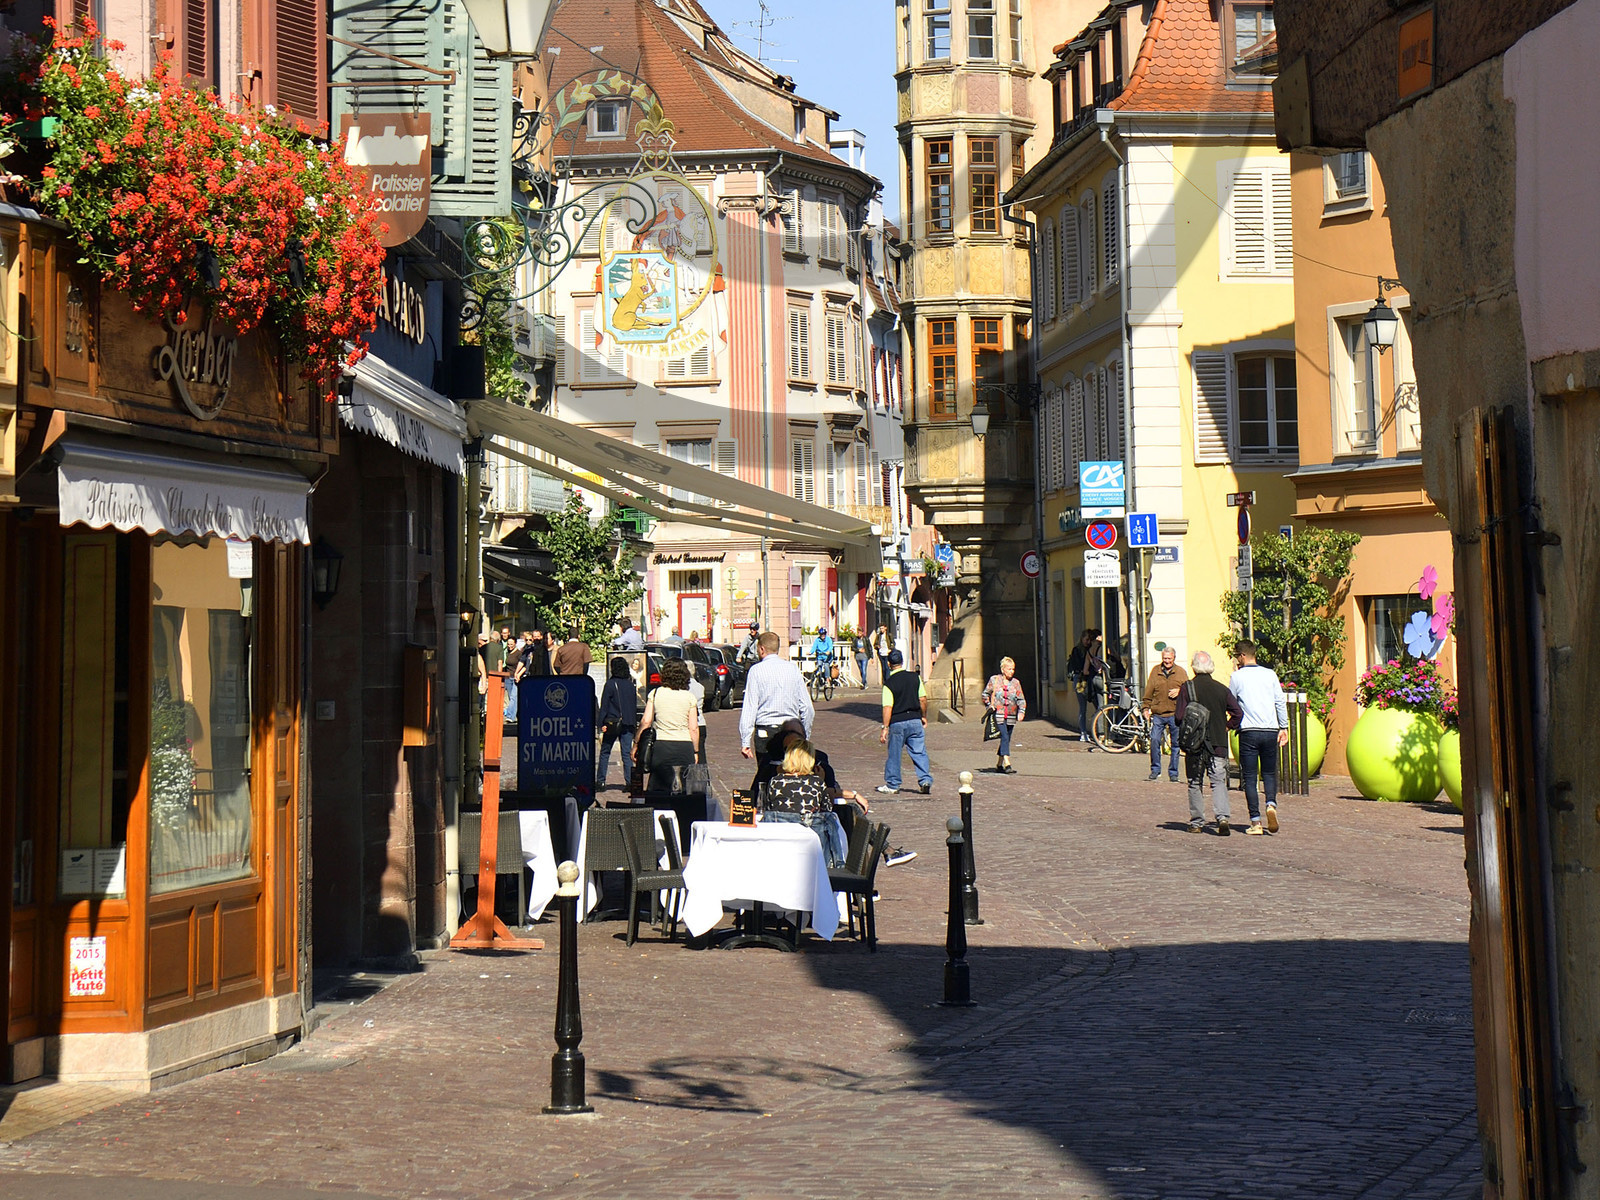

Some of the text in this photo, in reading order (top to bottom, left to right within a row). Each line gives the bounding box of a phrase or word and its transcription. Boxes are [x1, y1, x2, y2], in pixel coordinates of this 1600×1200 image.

[369, 194, 425, 212] colatier
[392, 274, 425, 345] PACO
[159, 297, 238, 421] Lorber
[530, 717, 573, 737] HOTEL
[524, 742, 590, 762] ST MARTIN
[557, 767, 564, 775] de
[76, 949, 99, 959] 2015
